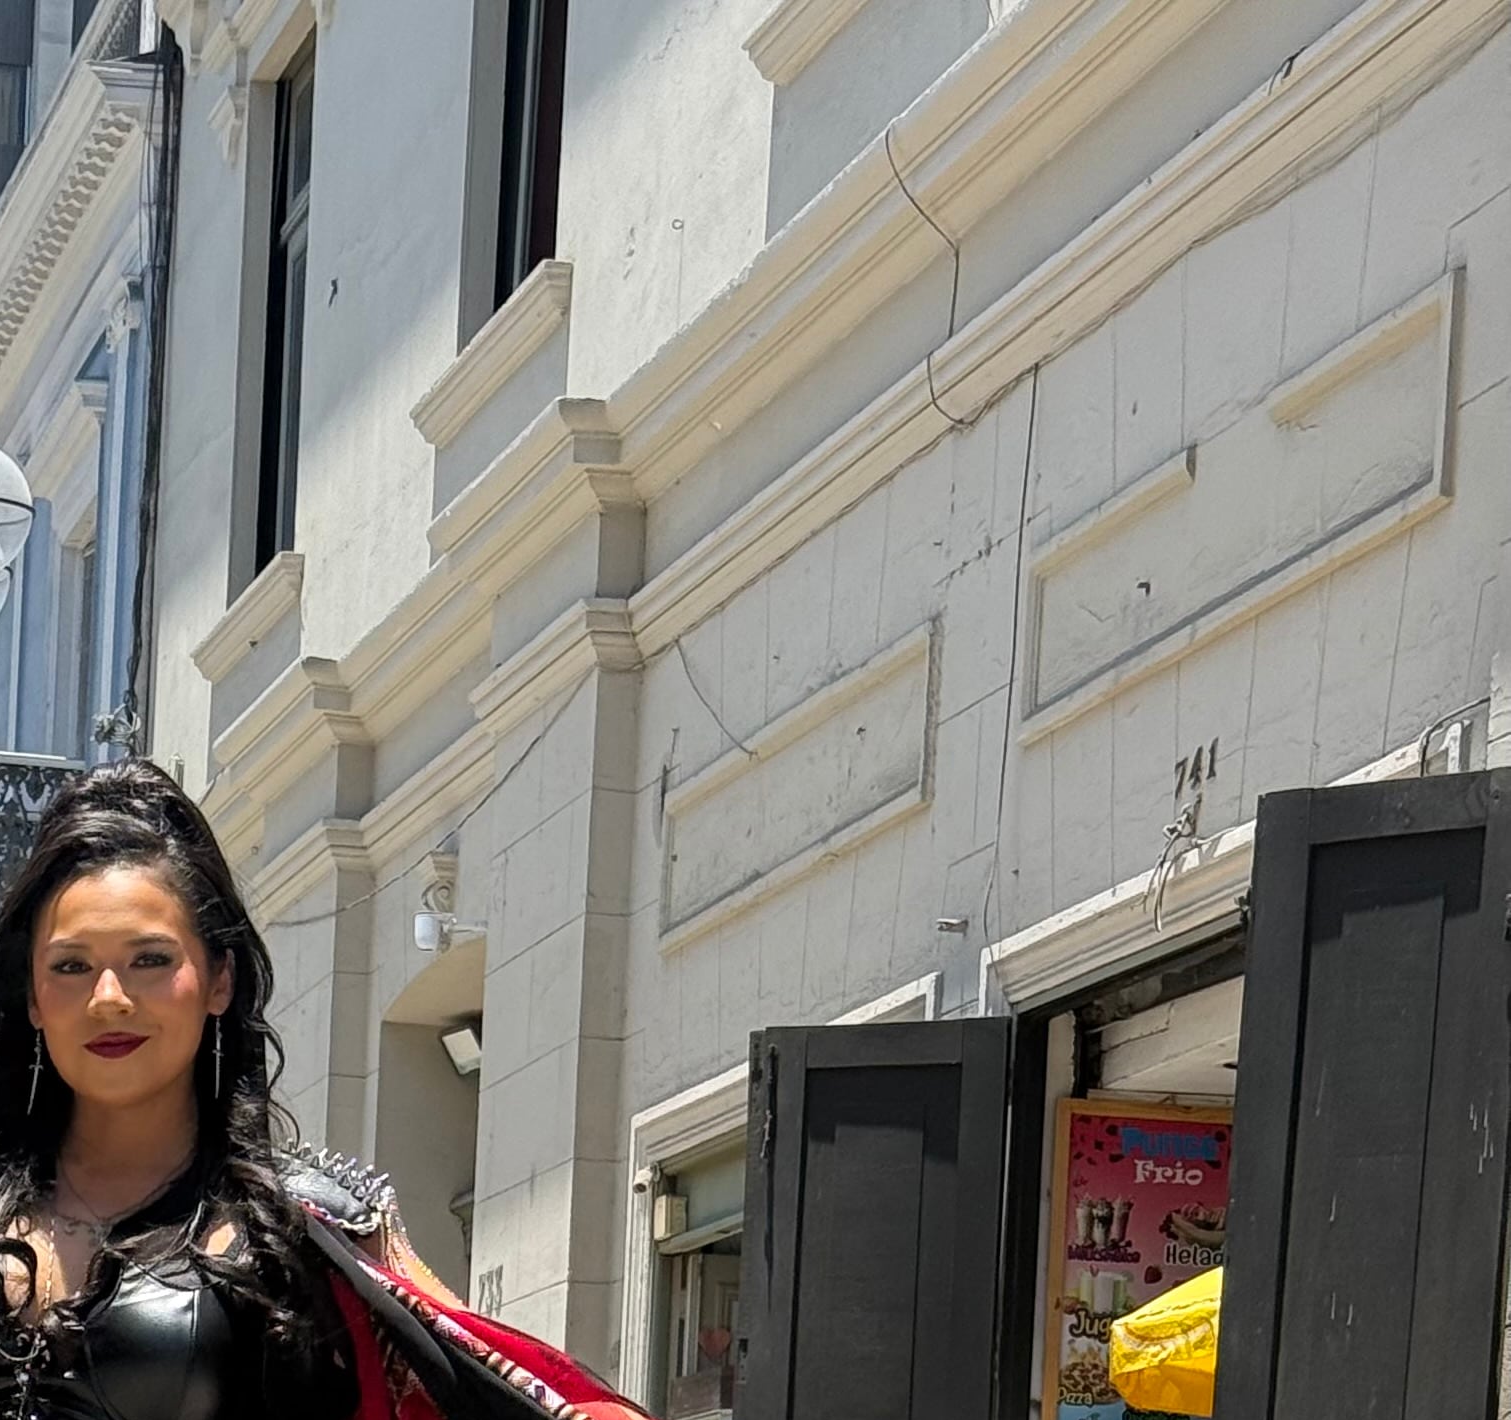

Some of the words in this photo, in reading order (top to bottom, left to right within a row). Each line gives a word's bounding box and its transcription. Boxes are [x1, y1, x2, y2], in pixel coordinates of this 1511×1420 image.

[1175, 737, 1219, 800] 741
[1134, 1159, 1203, 1186] Frio
[1165, 1243, 1225, 1266] Helad
[1070, 1309, 1112, 1336] Jug
